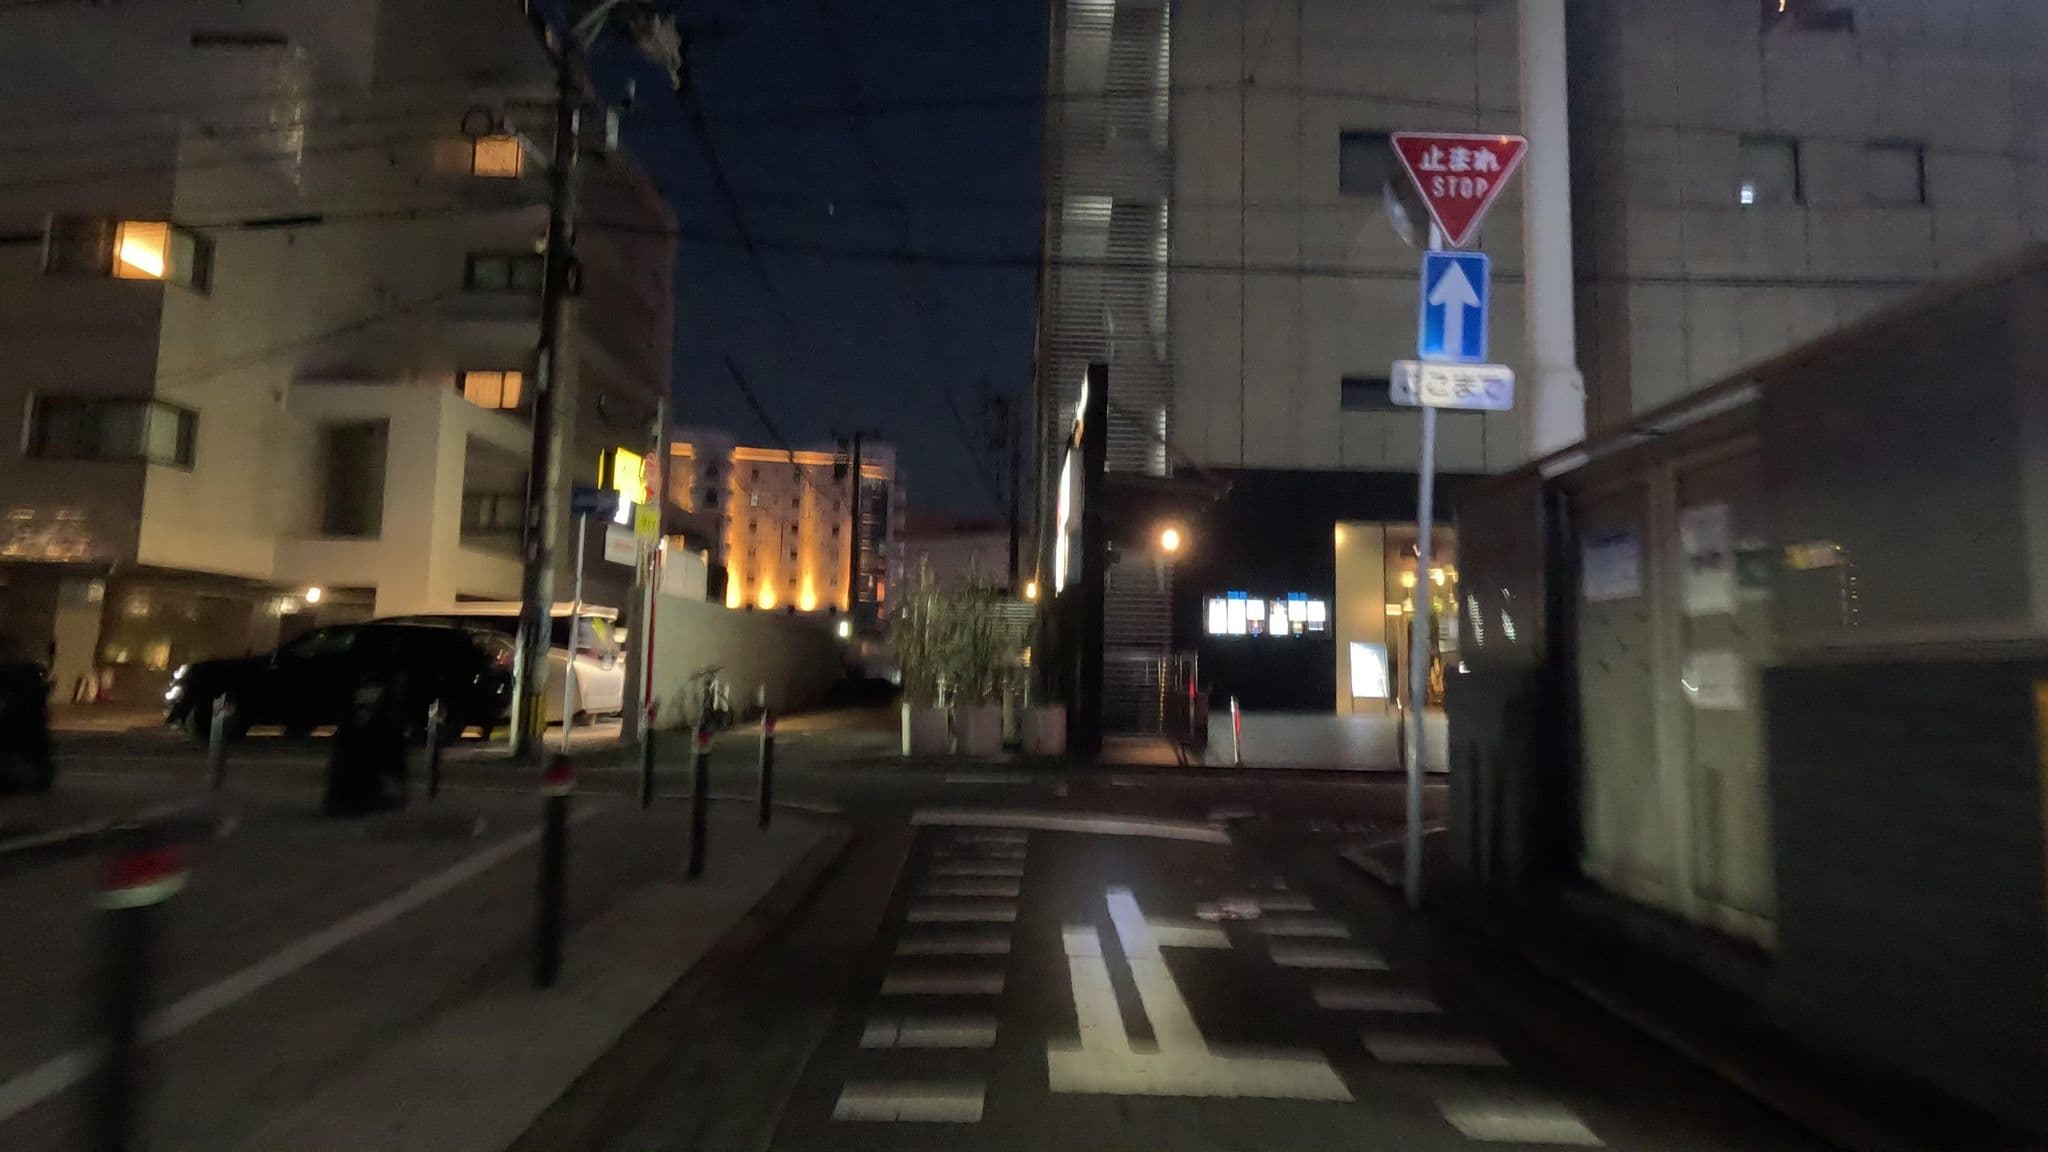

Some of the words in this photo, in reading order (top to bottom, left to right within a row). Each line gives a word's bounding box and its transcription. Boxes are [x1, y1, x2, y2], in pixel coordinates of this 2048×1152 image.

[1419, 144, 1501, 172] 止まれ
[1431, 175, 1489, 199] STOP
